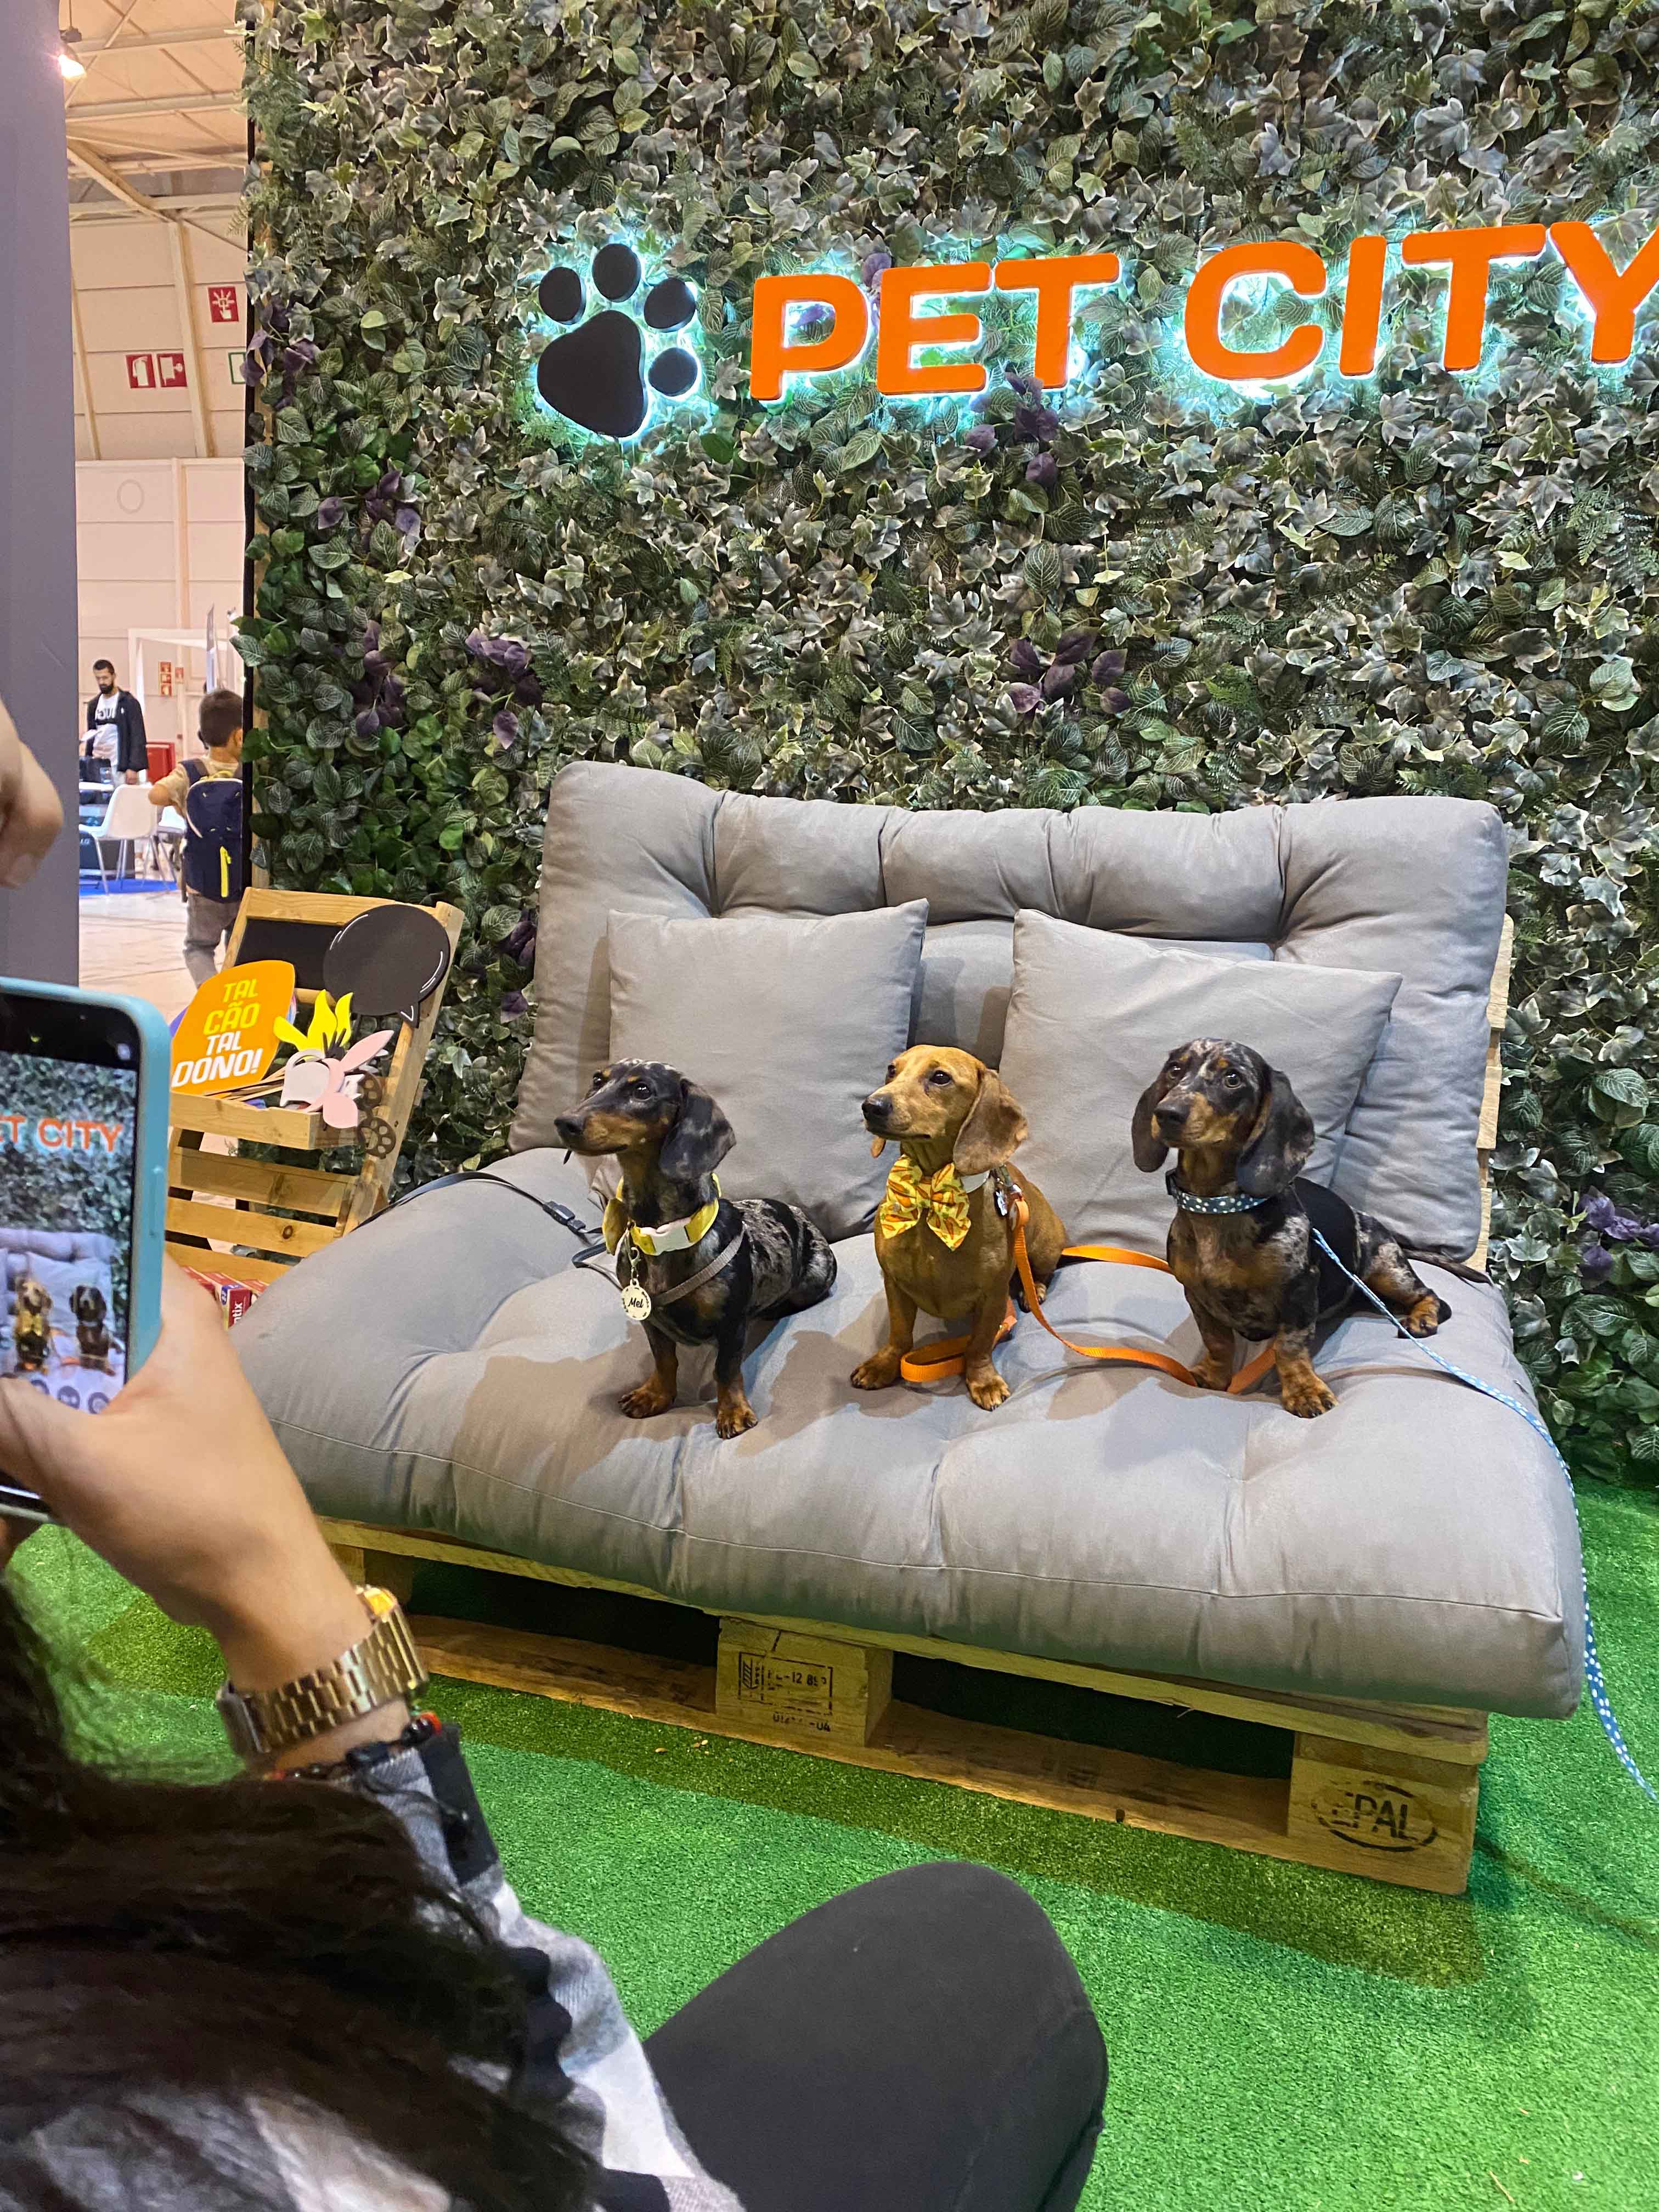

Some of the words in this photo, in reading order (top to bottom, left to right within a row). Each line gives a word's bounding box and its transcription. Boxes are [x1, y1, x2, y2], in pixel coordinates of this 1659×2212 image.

[751, 253, 1120, 400] PET
[1184, 221, 1659, 380] CITY
[223, 978, 258, 1003] TAL
[203, 1000, 261, 1035] CÃO
[206, 1030, 242, 1056] TAL
[171, 1048, 264, 1088] DONO!
[0, 1114, 27, 1143] T
[38, 1117, 123, 1152] CITY
[628, 1296, 644, 1308] Mel
